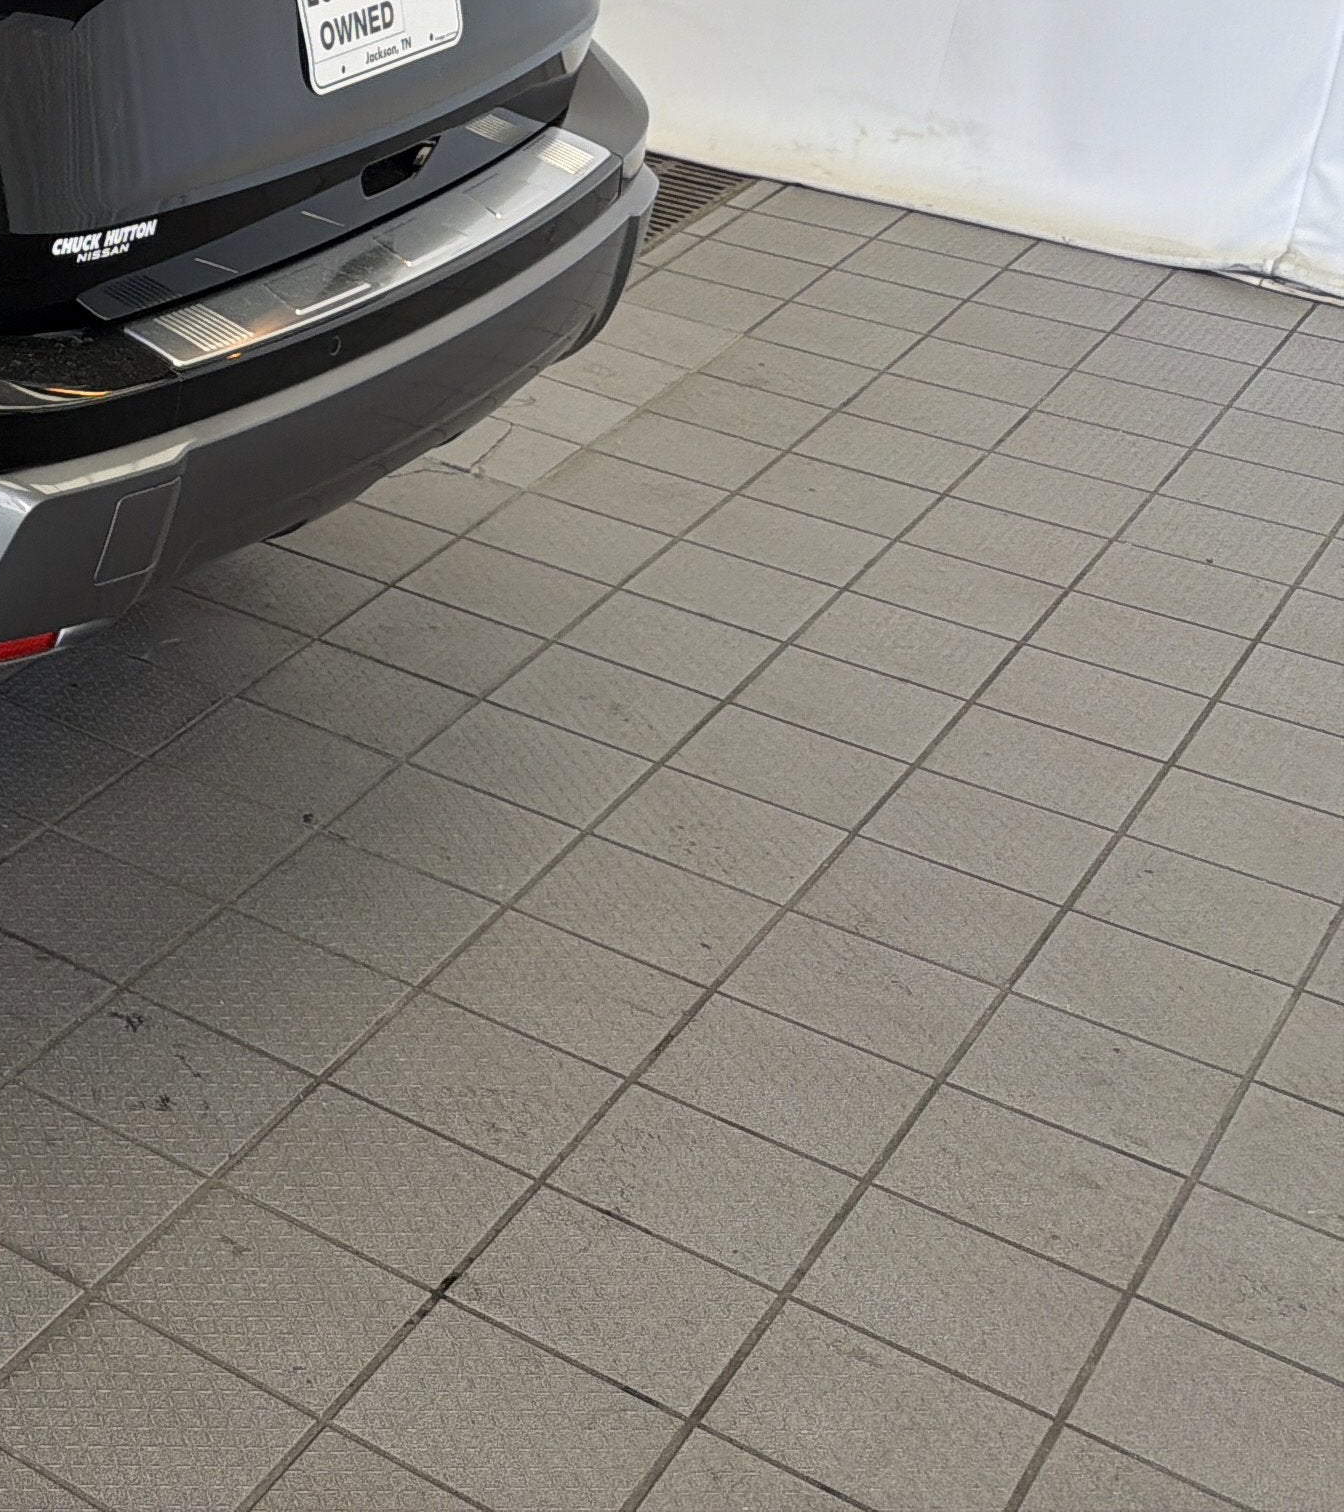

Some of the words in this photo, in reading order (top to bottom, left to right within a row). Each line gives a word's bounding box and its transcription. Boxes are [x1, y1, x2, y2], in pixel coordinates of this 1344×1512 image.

[320, 1, 394, 50] OWNED
[365, 45, 400, 64] Jackson,
[401, 36, 412, 52] TN
[52, 232, 103, 256] CHUCK
[104, 219, 158, 247] HUTTON
[76, 243, 130, 263] NISSAN
